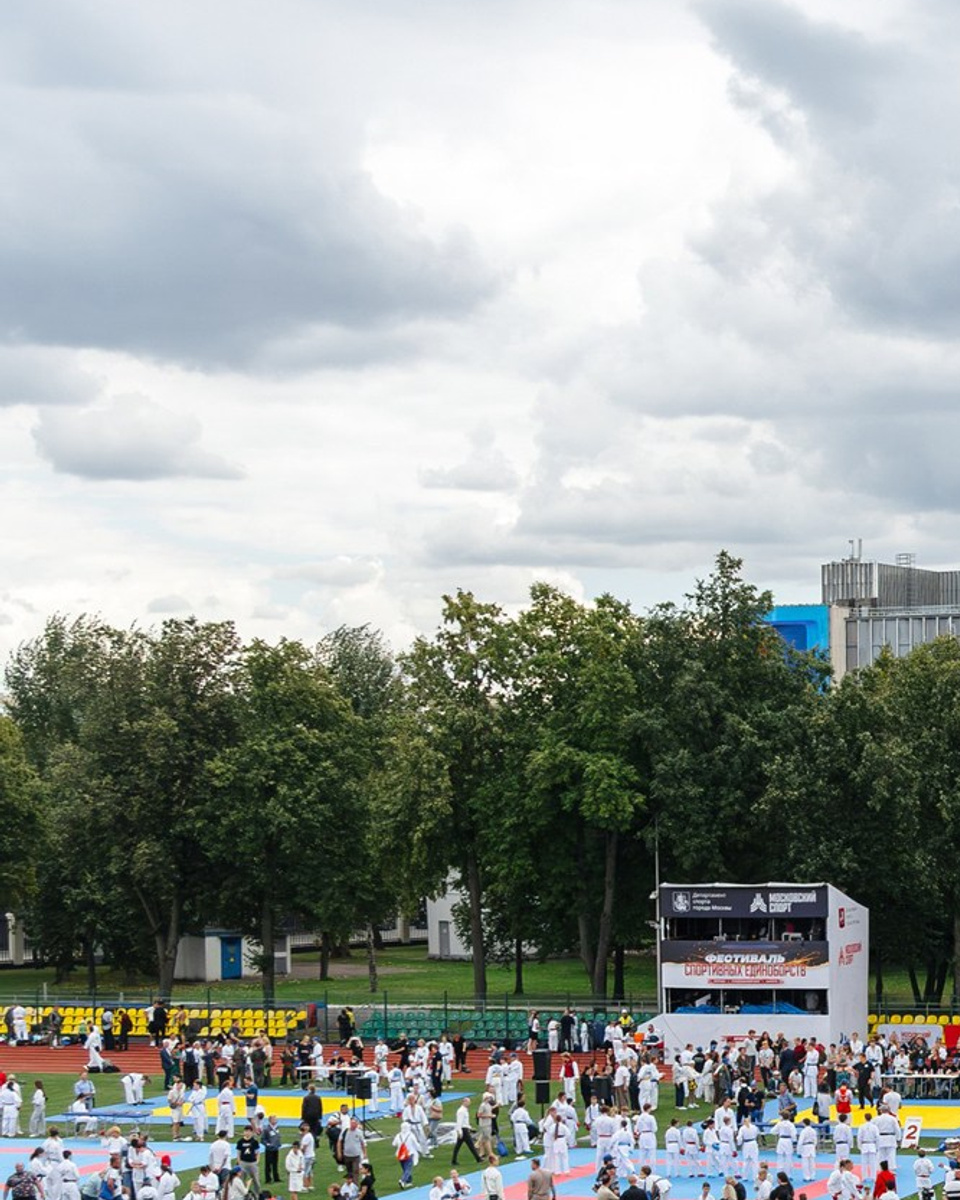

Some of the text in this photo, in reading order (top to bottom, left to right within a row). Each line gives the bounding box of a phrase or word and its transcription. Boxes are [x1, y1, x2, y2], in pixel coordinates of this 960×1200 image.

[705, 953, 786, 964] ФЕСТИВАЛЬ
[684, 963, 807, 978] СПОРТИВНЫХ ЕДИНОБОРСТВ
[905, 1124, 918, 1140] 2
